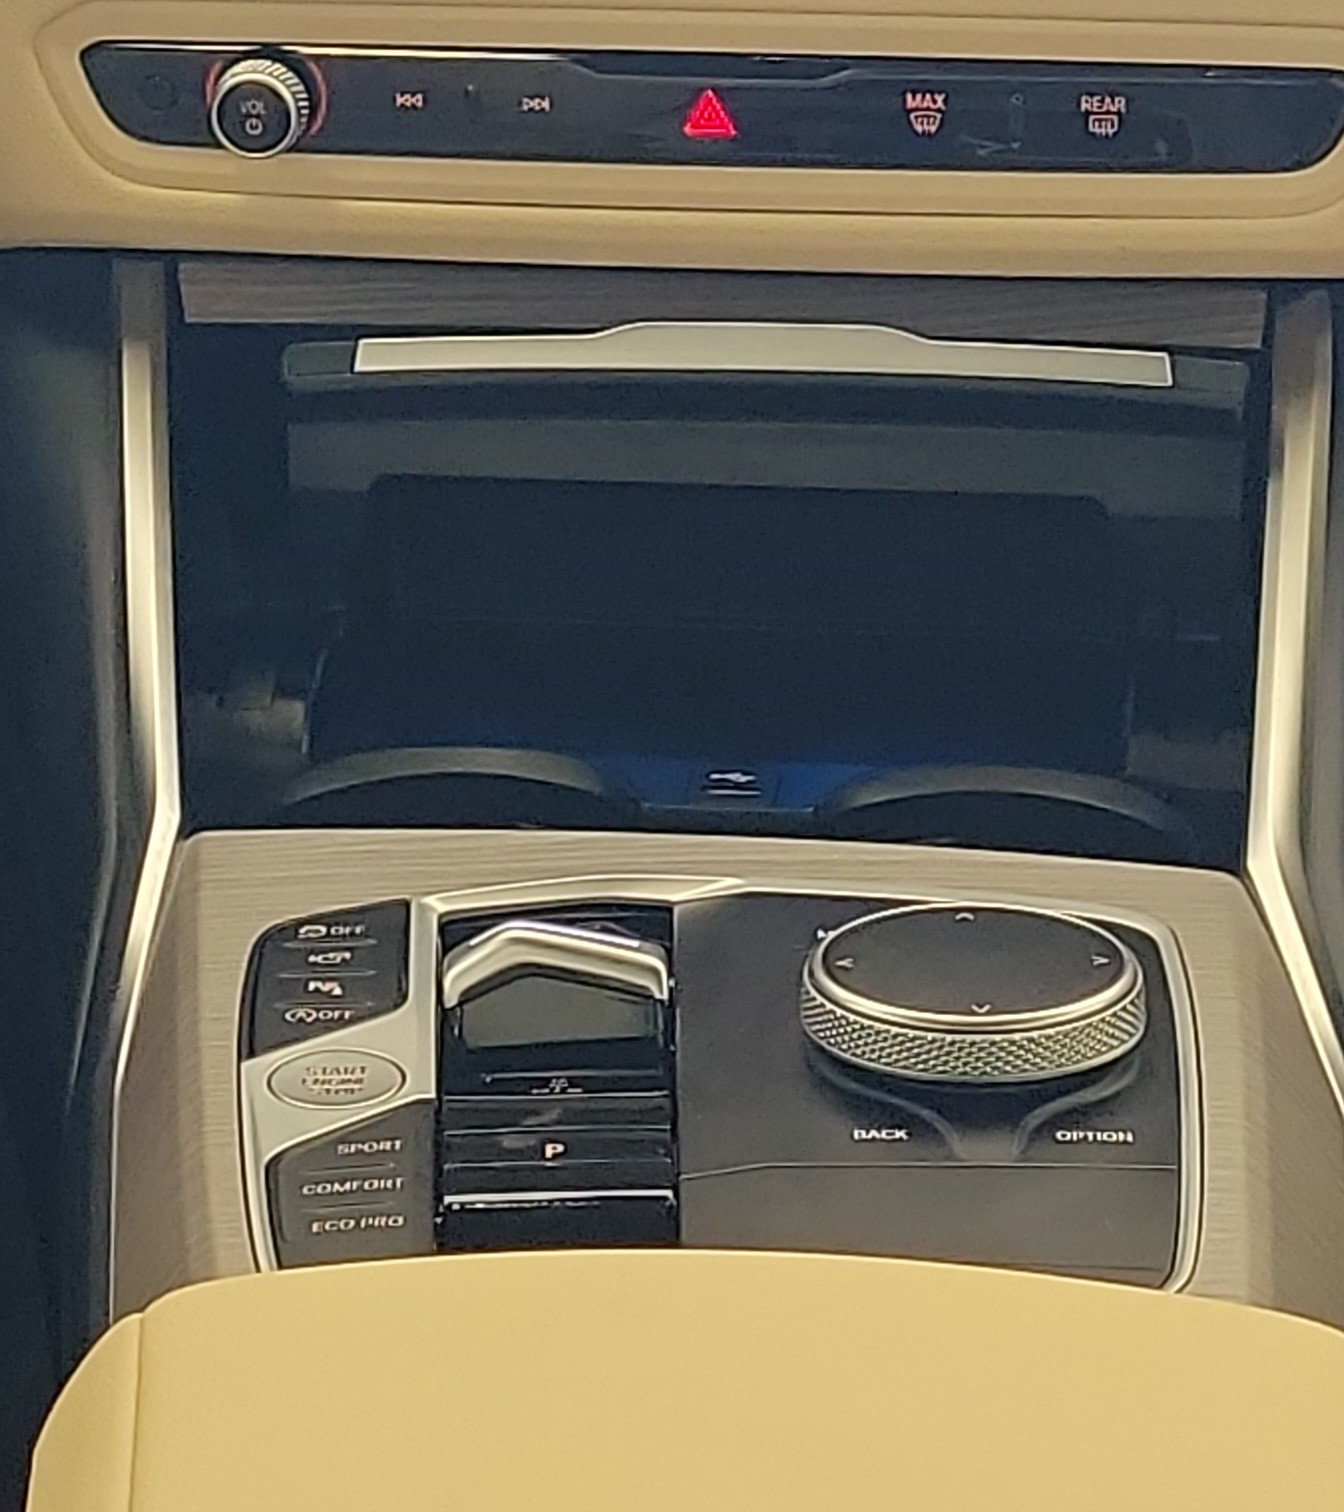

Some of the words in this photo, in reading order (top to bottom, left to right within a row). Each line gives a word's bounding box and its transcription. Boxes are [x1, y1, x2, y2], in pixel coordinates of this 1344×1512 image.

[239, 99, 266, 115] VOL
[905, 93, 947, 111] MAX
[1080, 95, 1126, 114] REAR
[329, 924, 366, 936] OFF
[318, 1009, 356, 1021] OFF
[853, 1128, 909, 1142] BACK
[1055, 1129, 1135, 1144] OPTION
[336, 1139, 403, 1156] SPORT
[544, 1142, 565, 1159] P
[301, 1176, 405, 1196] COMFORT
[311, 1218, 357, 1235] ECO
[359, 1215, 405, 1230] PRO
